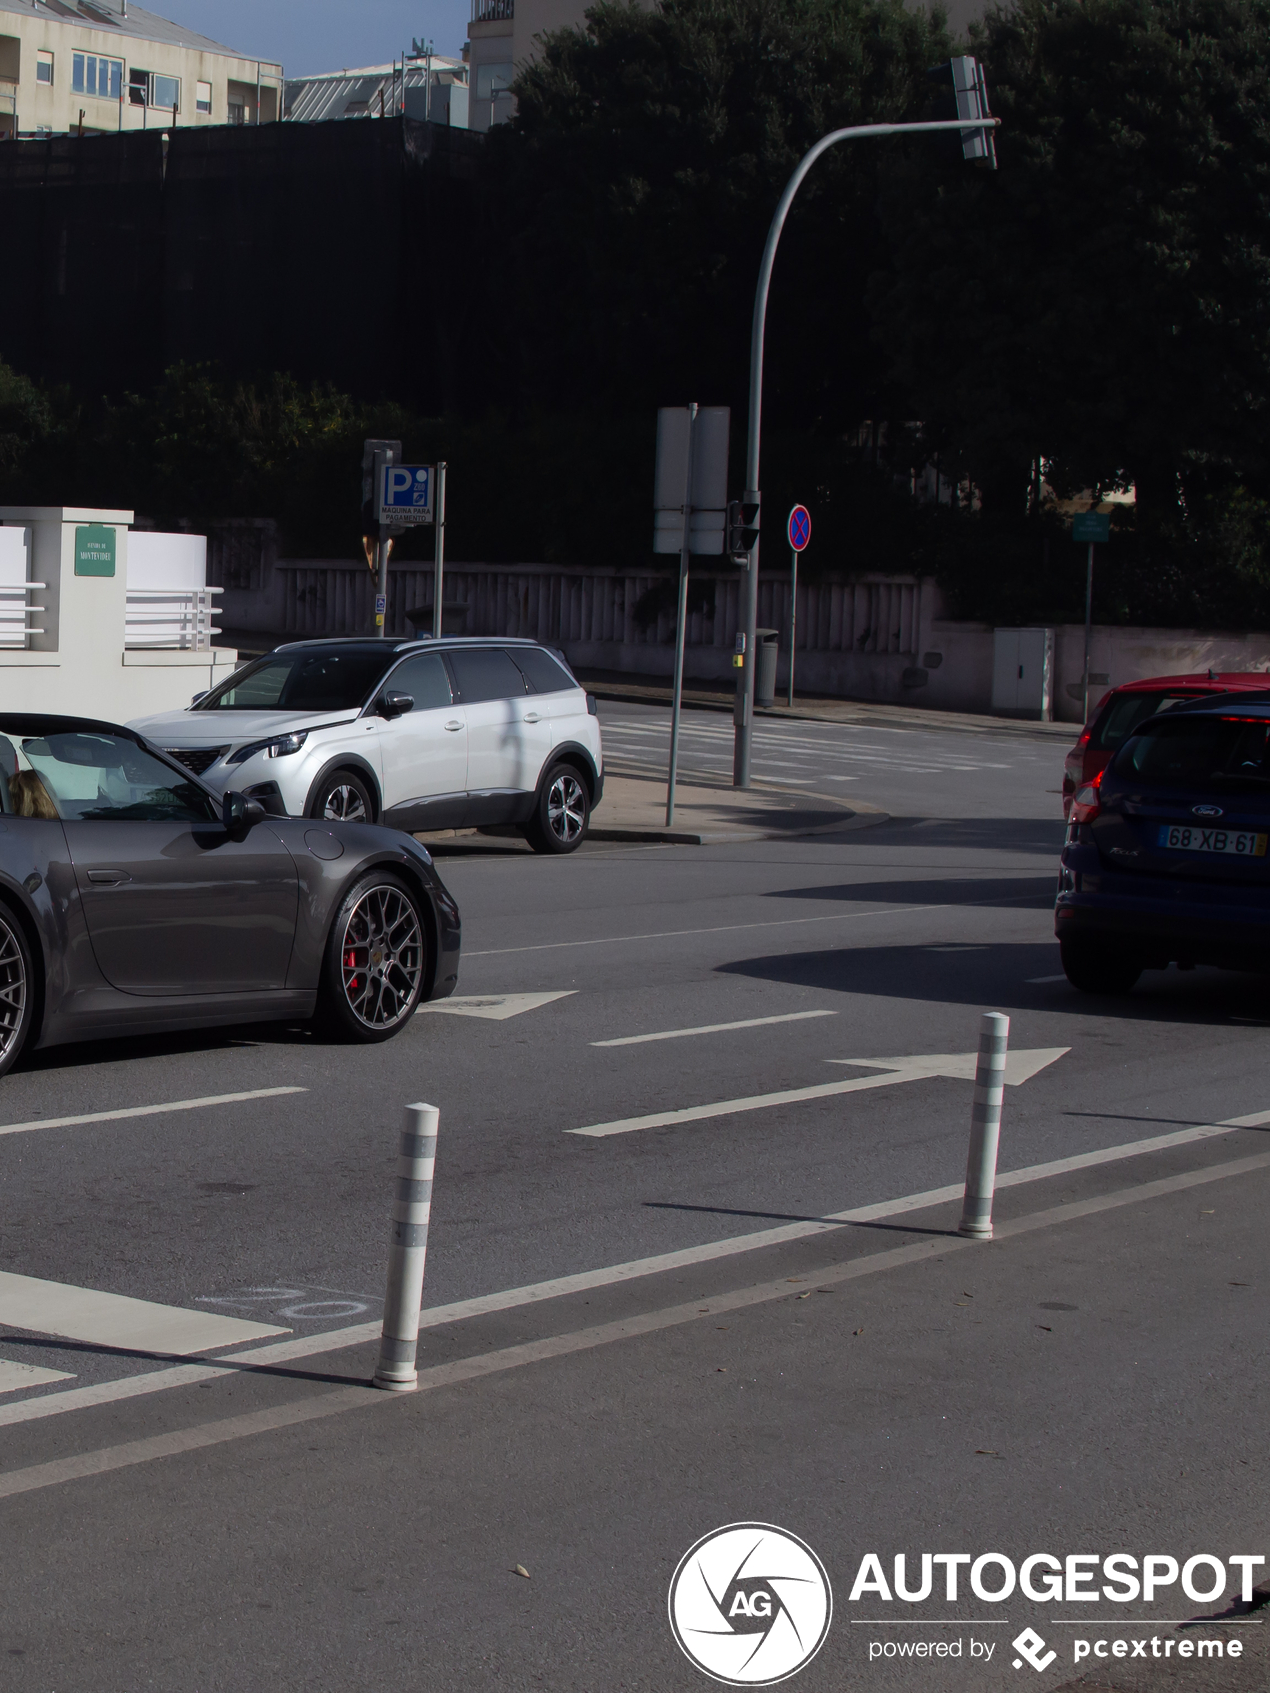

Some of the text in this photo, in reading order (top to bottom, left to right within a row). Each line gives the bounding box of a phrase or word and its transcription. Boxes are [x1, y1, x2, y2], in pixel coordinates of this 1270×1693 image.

[387, 468, 412, 505] P
[413, 507, 430, 515] PARA
[386, 514, 426, 522] PAGAMENTO
